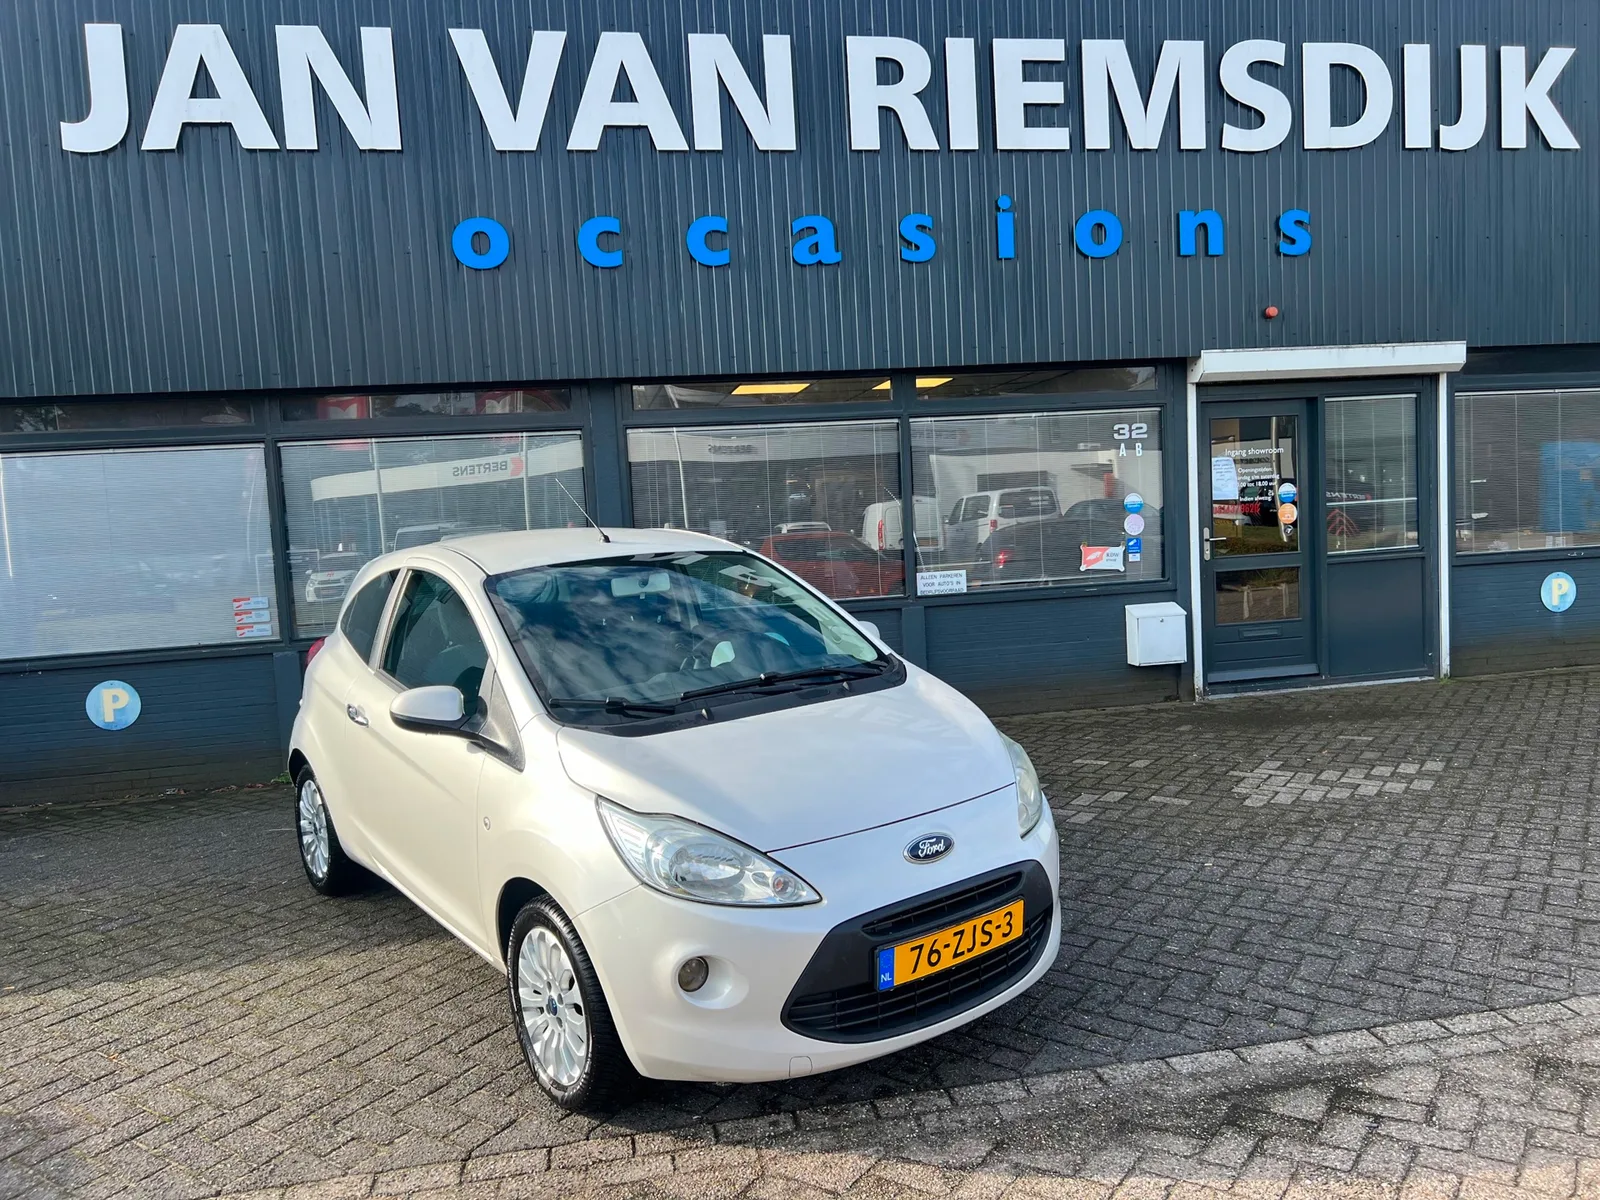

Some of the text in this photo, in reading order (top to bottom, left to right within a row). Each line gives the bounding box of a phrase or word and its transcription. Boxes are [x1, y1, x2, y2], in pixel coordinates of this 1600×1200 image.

[60, 23, 1581, 153] JAN VAN RIEMSDIJK
[451, 195, 1313, 271] occasions
[1113, 423, 1148, 439] 32
[1119, 443, 1142, 456] A B
[1225, 447, 1284, 457] Ingang showroom
[1552, 578, 1569, 606] P
[102, 688, 130, 723] P
[917, 837, 946, 858] Ford
[910, 911, 1013, 975] 76-ZJS-3
[880, 972, 892, 983] NL
